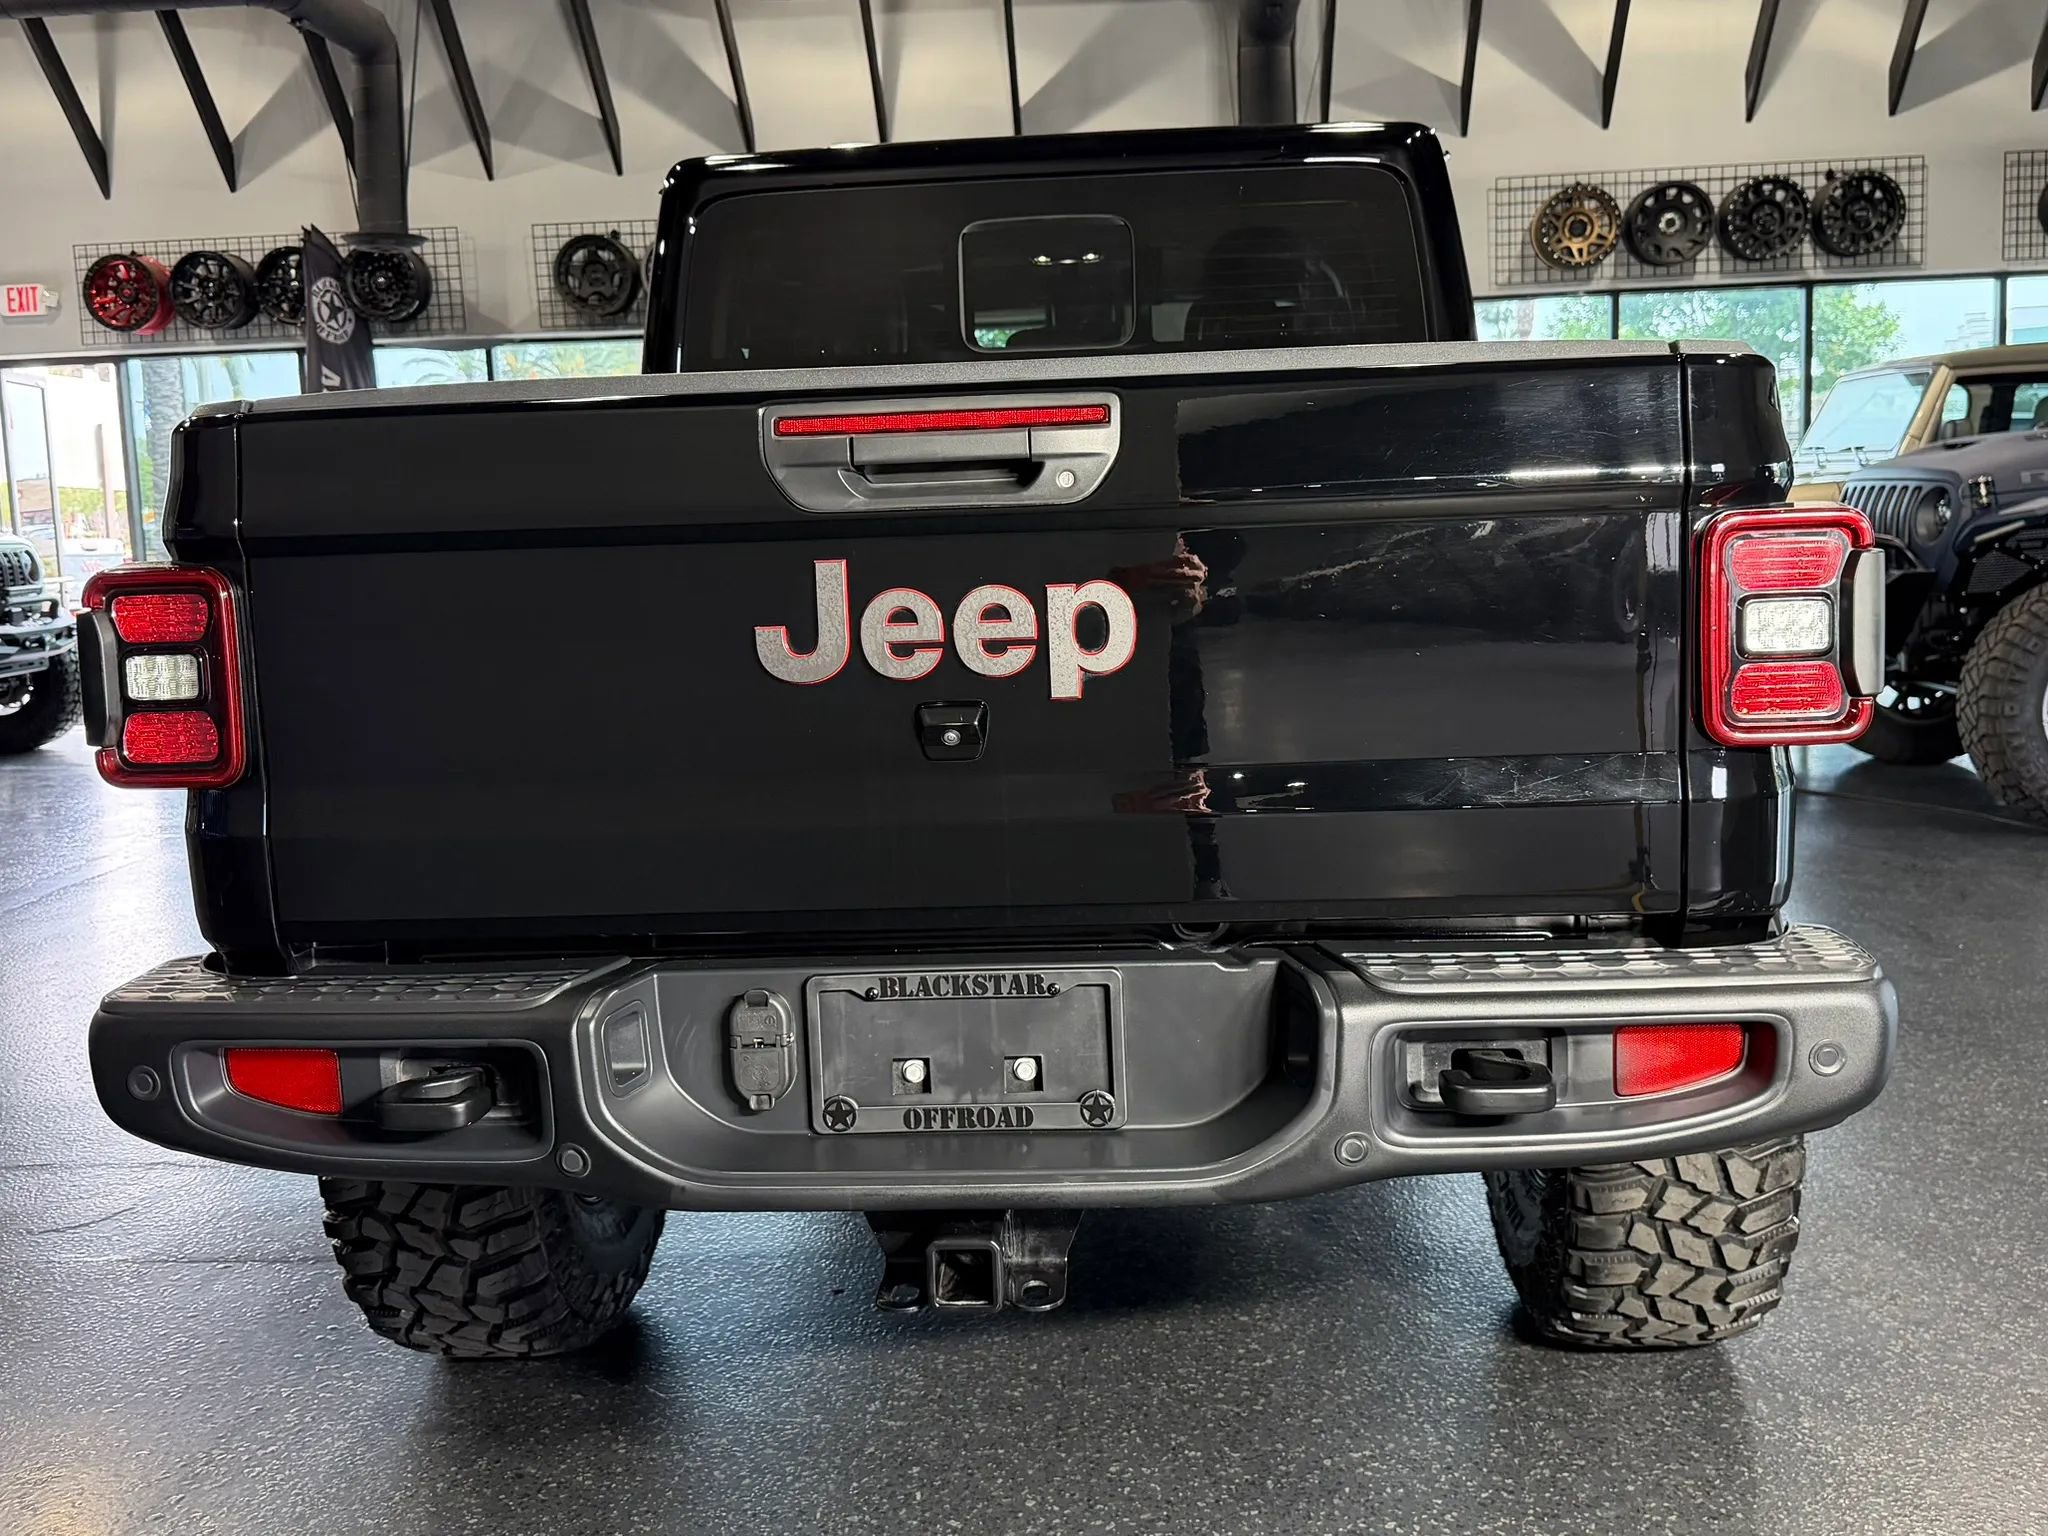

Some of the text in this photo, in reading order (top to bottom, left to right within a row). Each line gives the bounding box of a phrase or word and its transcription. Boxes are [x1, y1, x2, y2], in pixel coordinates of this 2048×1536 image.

[7, 286, 37, 312] EXIT
[754, 559, 1137, 700] Jeep
[879, 973, 1047, 998] BLACKSTAR
[903, 1105, 1034, 1130] OFFROAD
